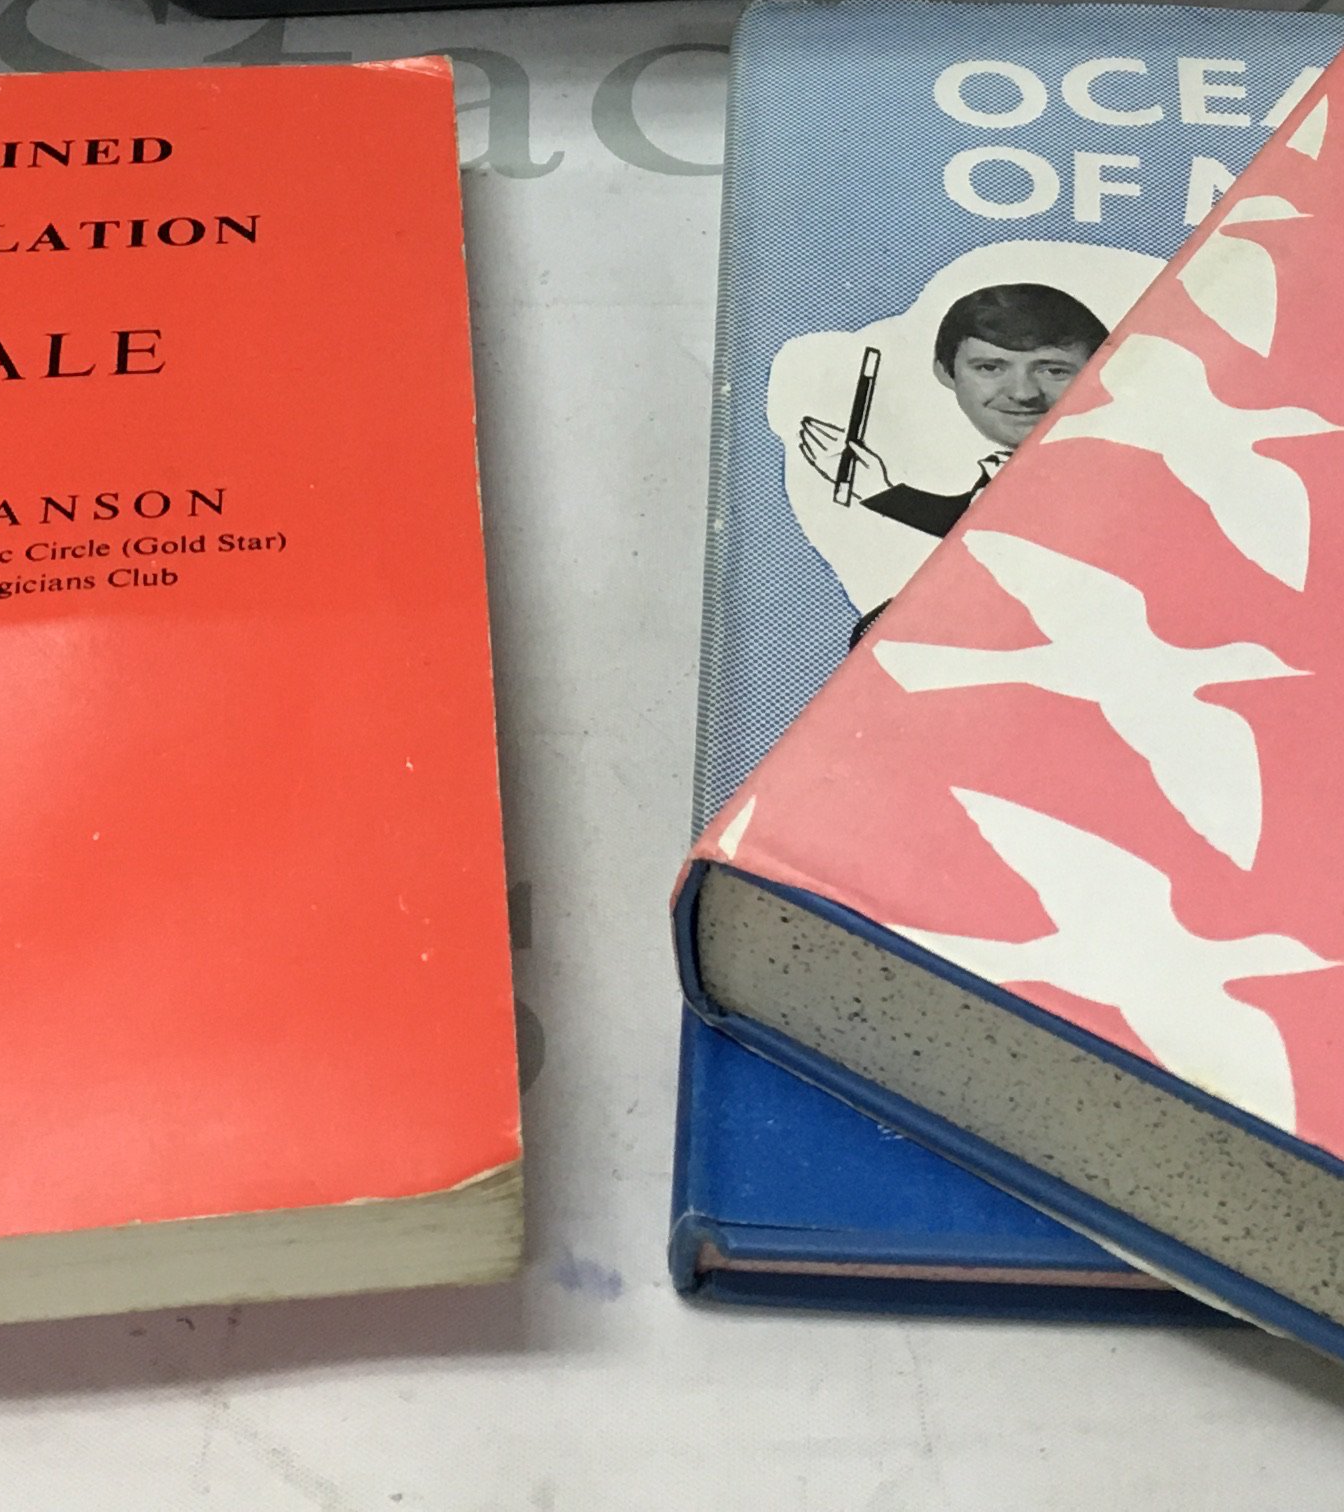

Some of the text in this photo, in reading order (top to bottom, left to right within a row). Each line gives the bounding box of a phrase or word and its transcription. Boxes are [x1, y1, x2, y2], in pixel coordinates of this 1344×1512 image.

[943, 144, 1143, 224] OF
[25, 539, 110, 562] Circle
[122, 534, 206, 558] (Gold
[218, 530, 287, 553] Star)
[107, 567, 179, 588] Club
